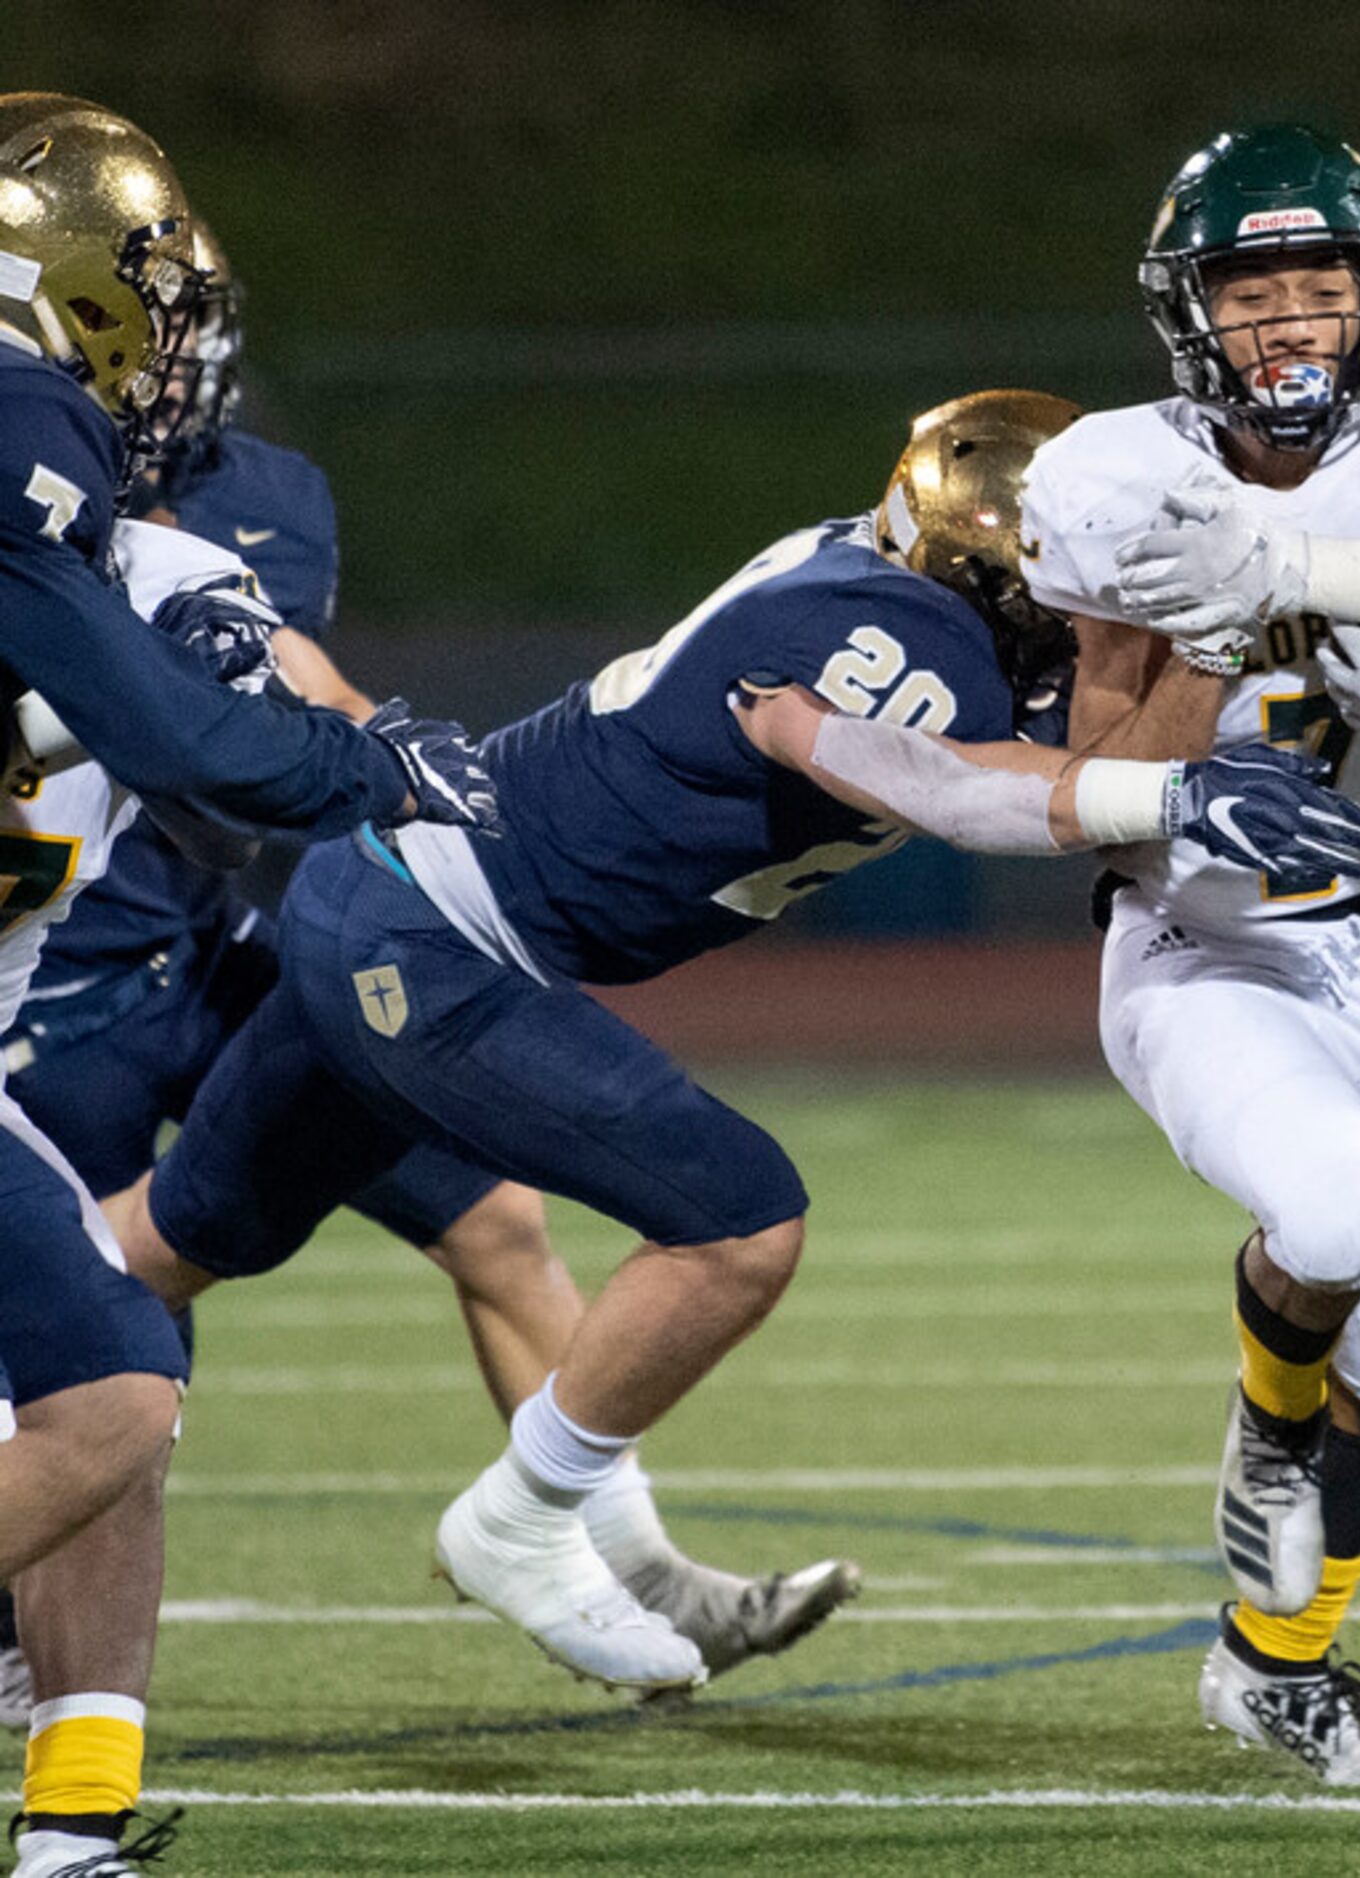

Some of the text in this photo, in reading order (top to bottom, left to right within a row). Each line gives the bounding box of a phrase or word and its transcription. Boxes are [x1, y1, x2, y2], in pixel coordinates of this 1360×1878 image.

[24, 463, 89, 543] 7
[812, 625, 957, 735] 20
[1241, 1689, 1332, 1779] adidas
